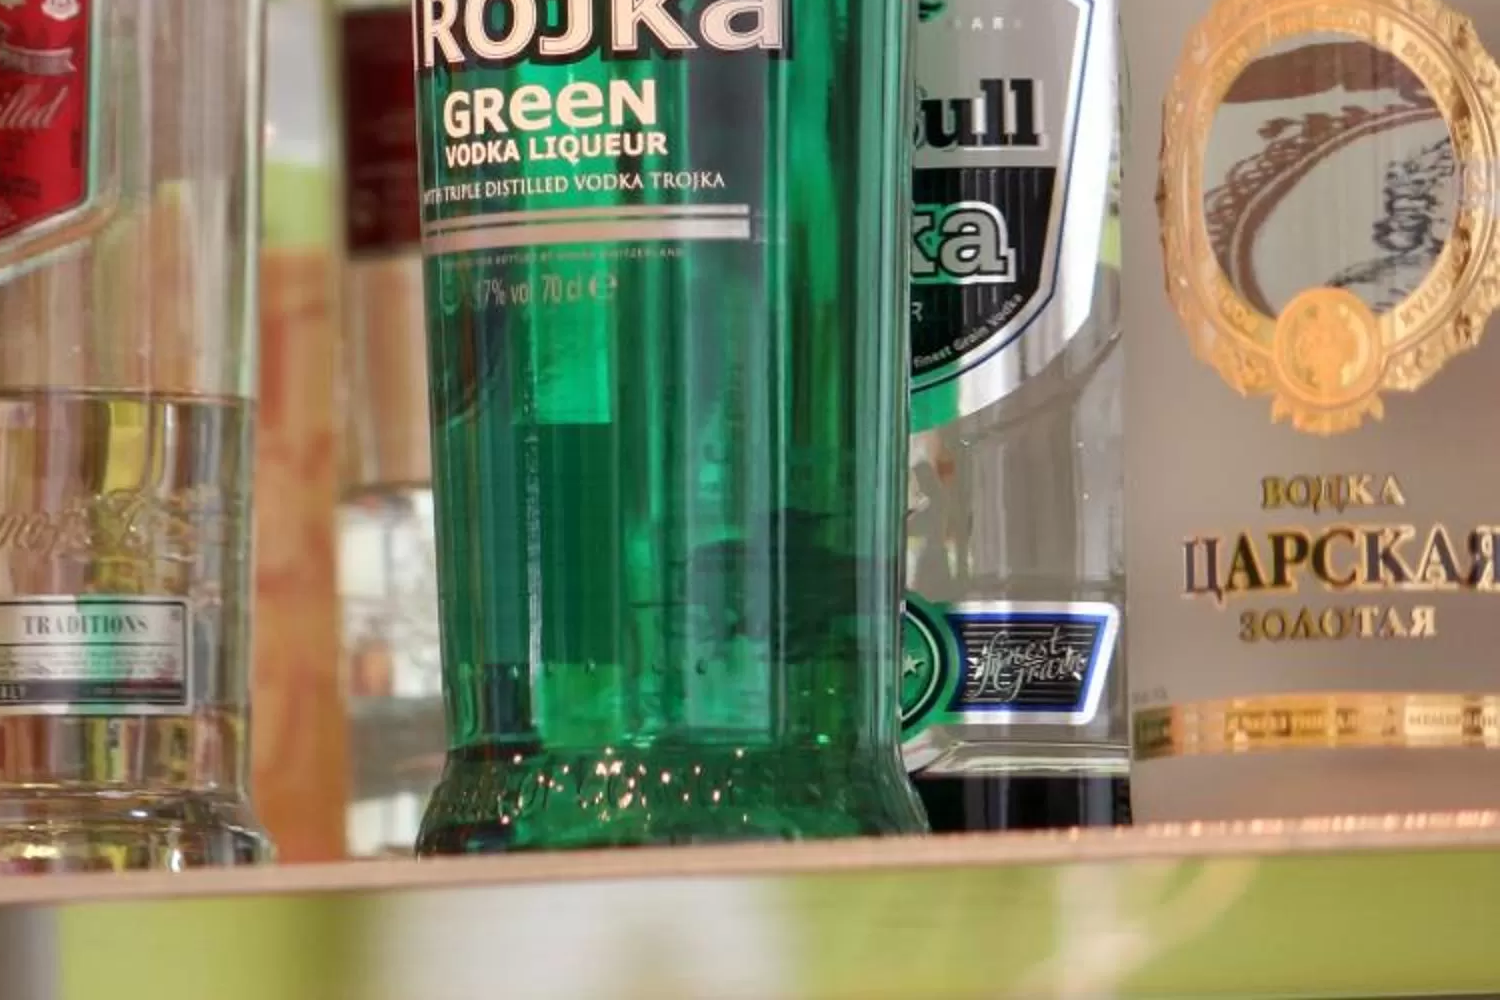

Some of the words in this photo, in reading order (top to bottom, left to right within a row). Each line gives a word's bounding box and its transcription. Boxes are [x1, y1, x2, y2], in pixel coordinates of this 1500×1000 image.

[913, 77, 1046, 150] ull
[445, 139, 521, 169] VODKA
[528, 130, 668, 165] LIQUEUR
[444, 181, 482, 202] TRIPLE
[484, 174, 569, 198] DISTILLED
[573, 171, 644, 193] VODKA
[651, 170, 726, 192] TROJKA
[1261, 472, 1406, 515] ВОДКА
[1181, 522, 1500, 611] ЦАРСКАЯ
[1238, 605, 1438, 643] ЗОЛОТАЯ
